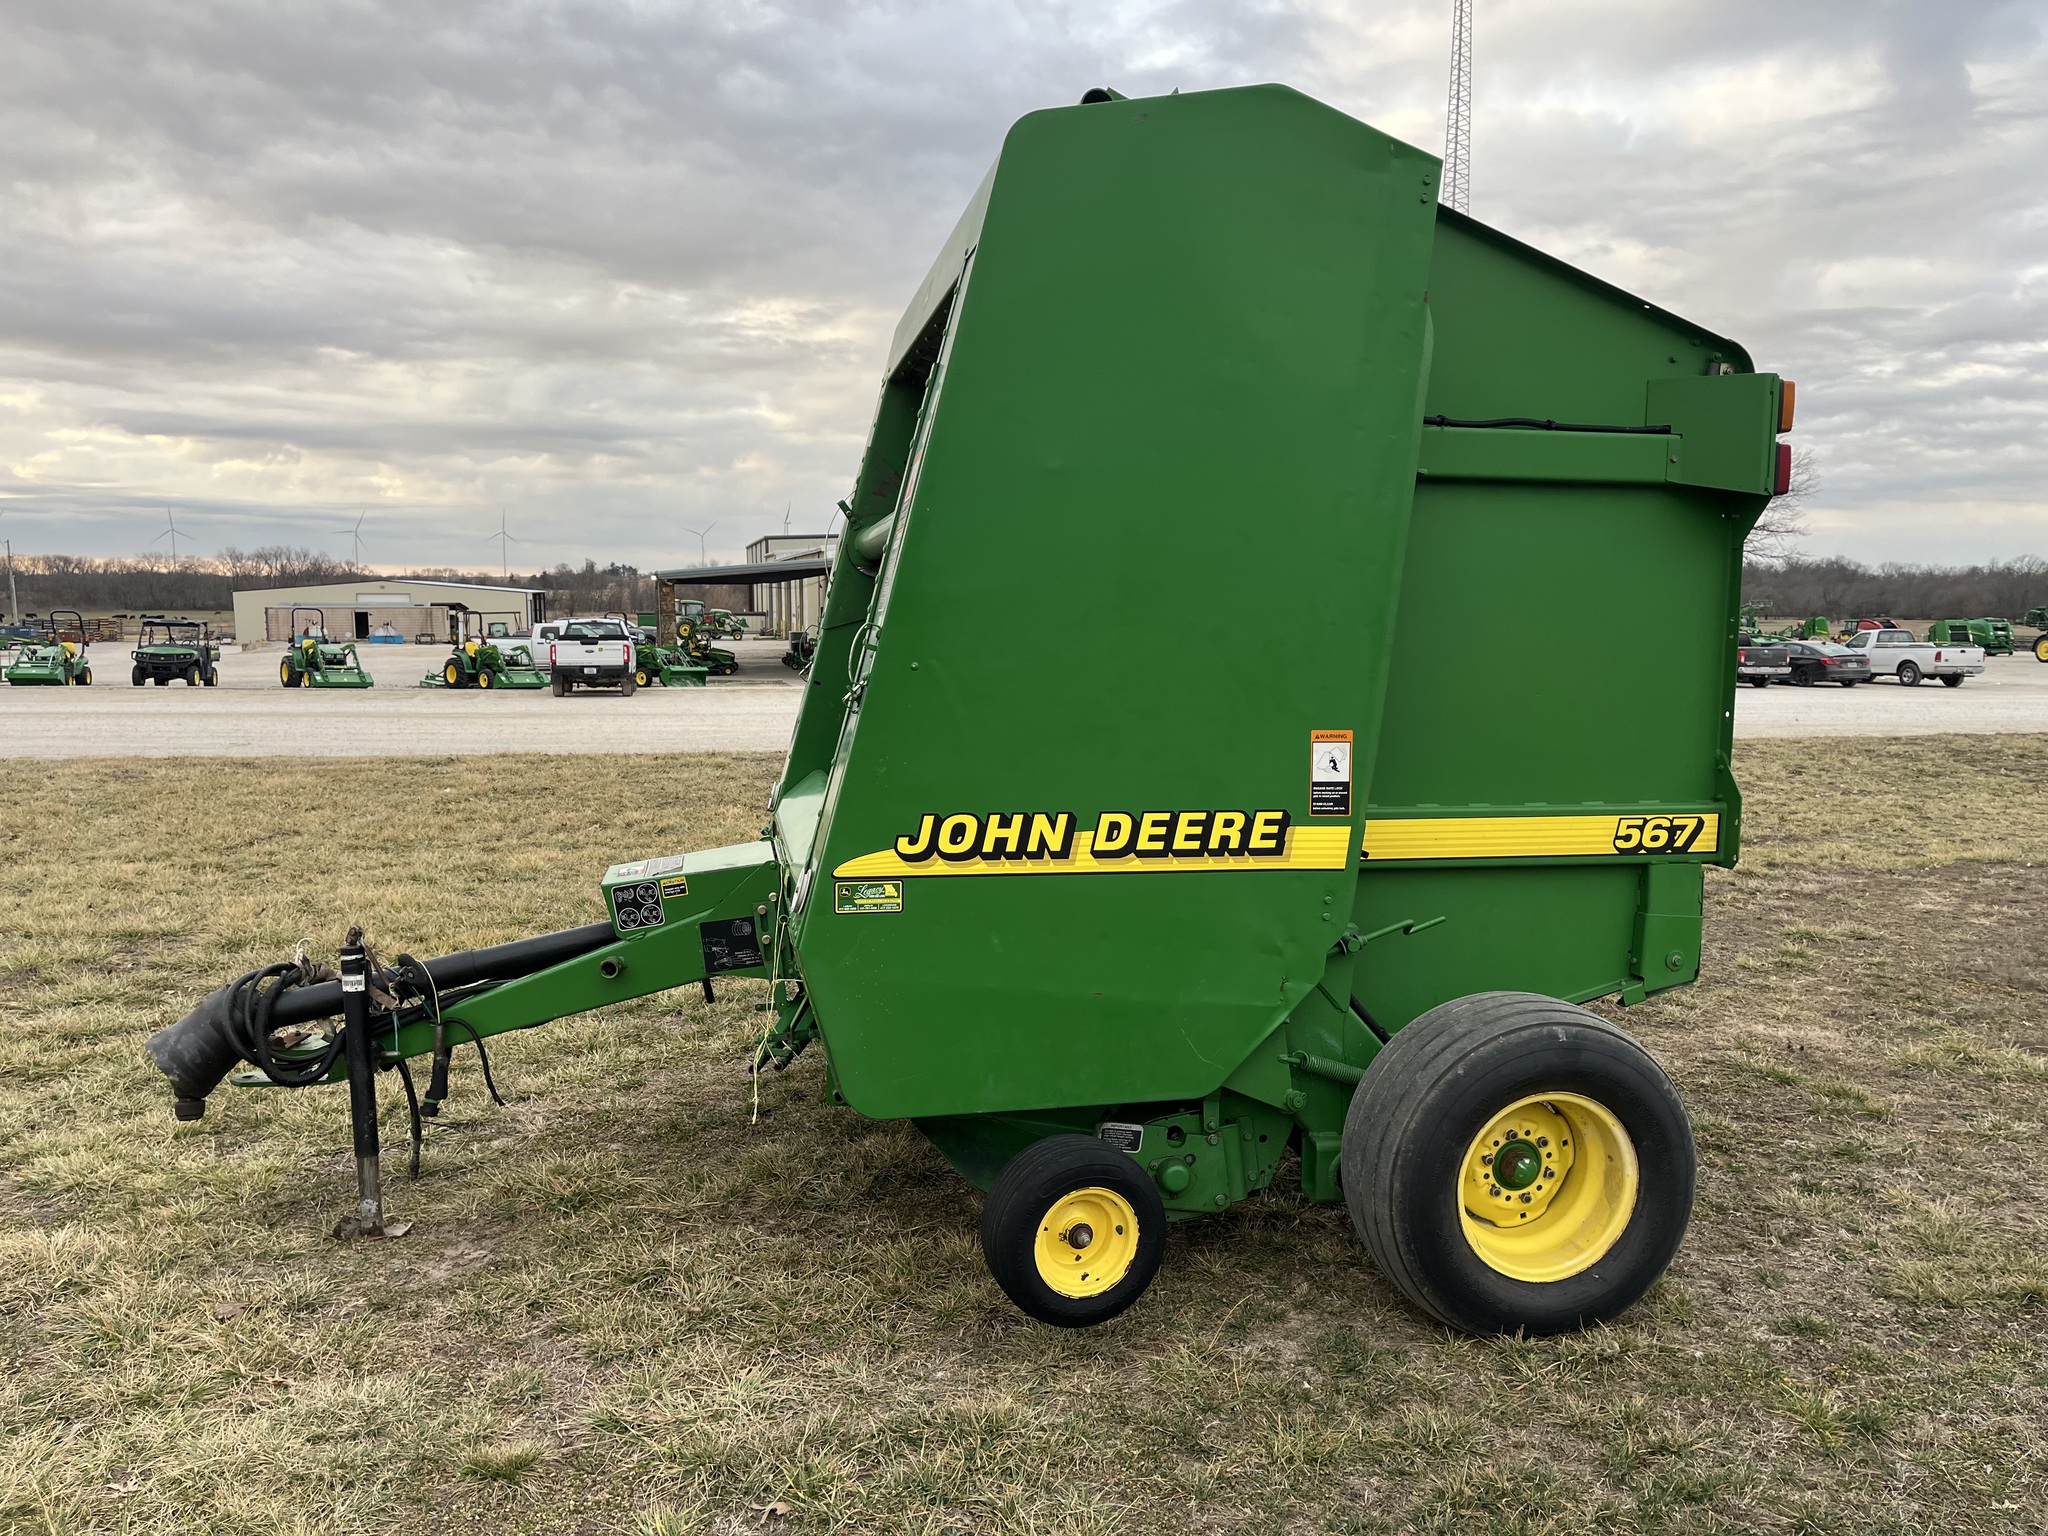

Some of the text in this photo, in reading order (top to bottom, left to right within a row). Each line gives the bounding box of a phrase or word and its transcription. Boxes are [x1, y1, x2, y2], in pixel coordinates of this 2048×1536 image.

[896, 810, 1289, 860] JOHN DEERE
[1614, 817, 1702, 853] 567
[854, 884, 885, 898] Legacy
